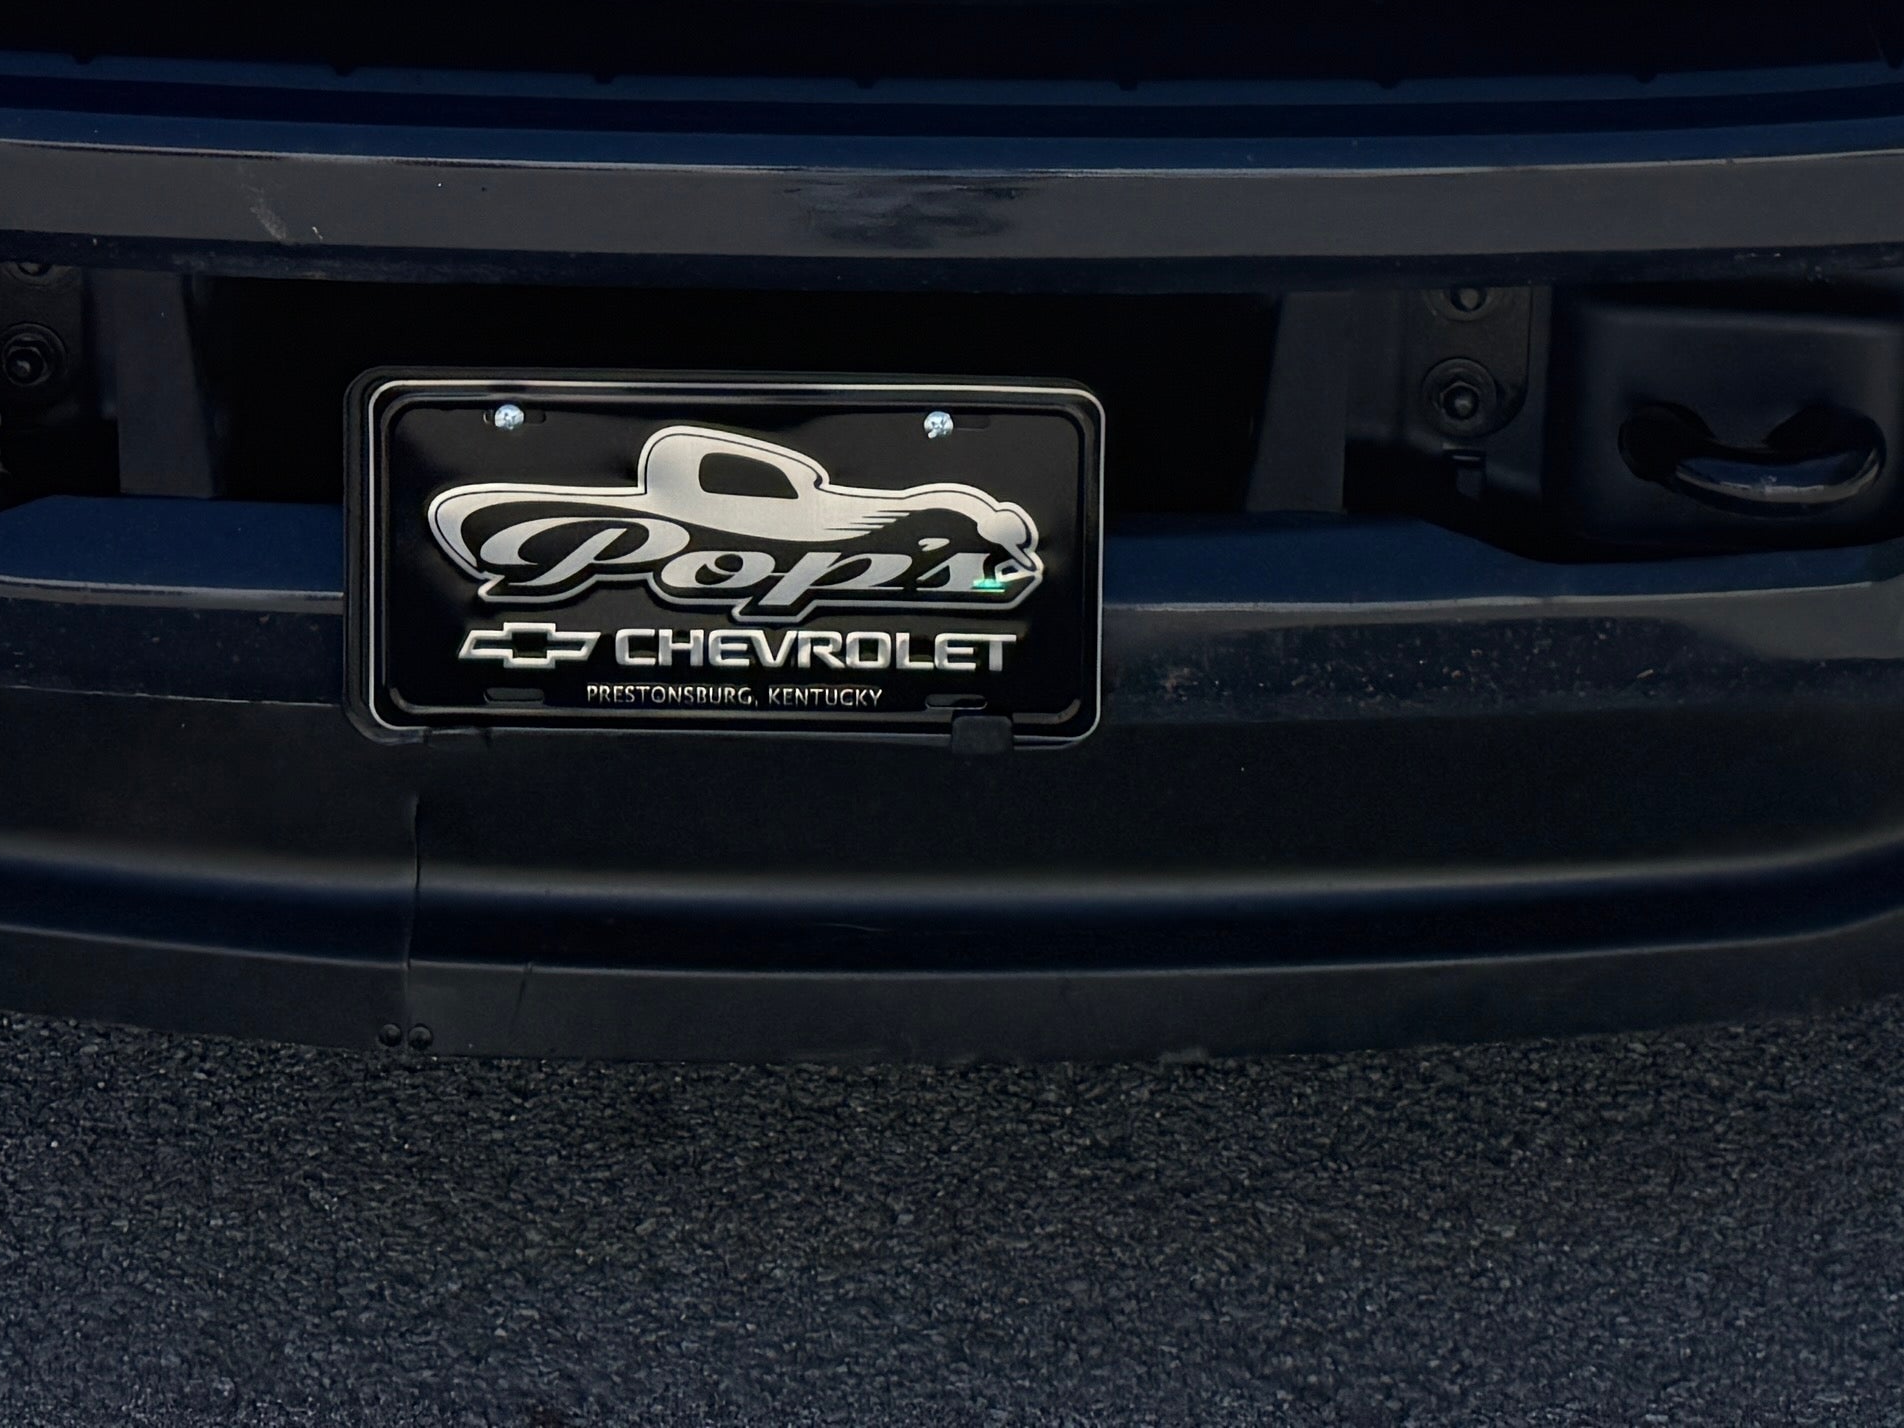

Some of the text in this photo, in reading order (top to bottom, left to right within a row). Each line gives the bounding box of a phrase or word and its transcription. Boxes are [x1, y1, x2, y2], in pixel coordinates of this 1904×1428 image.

[479, 517, 1006, 606] Pop's
[615, 628, 1017, 673] CHEVROLET
[586, 684, 883, 708] PRESTONSBURG, KENTUCKY
